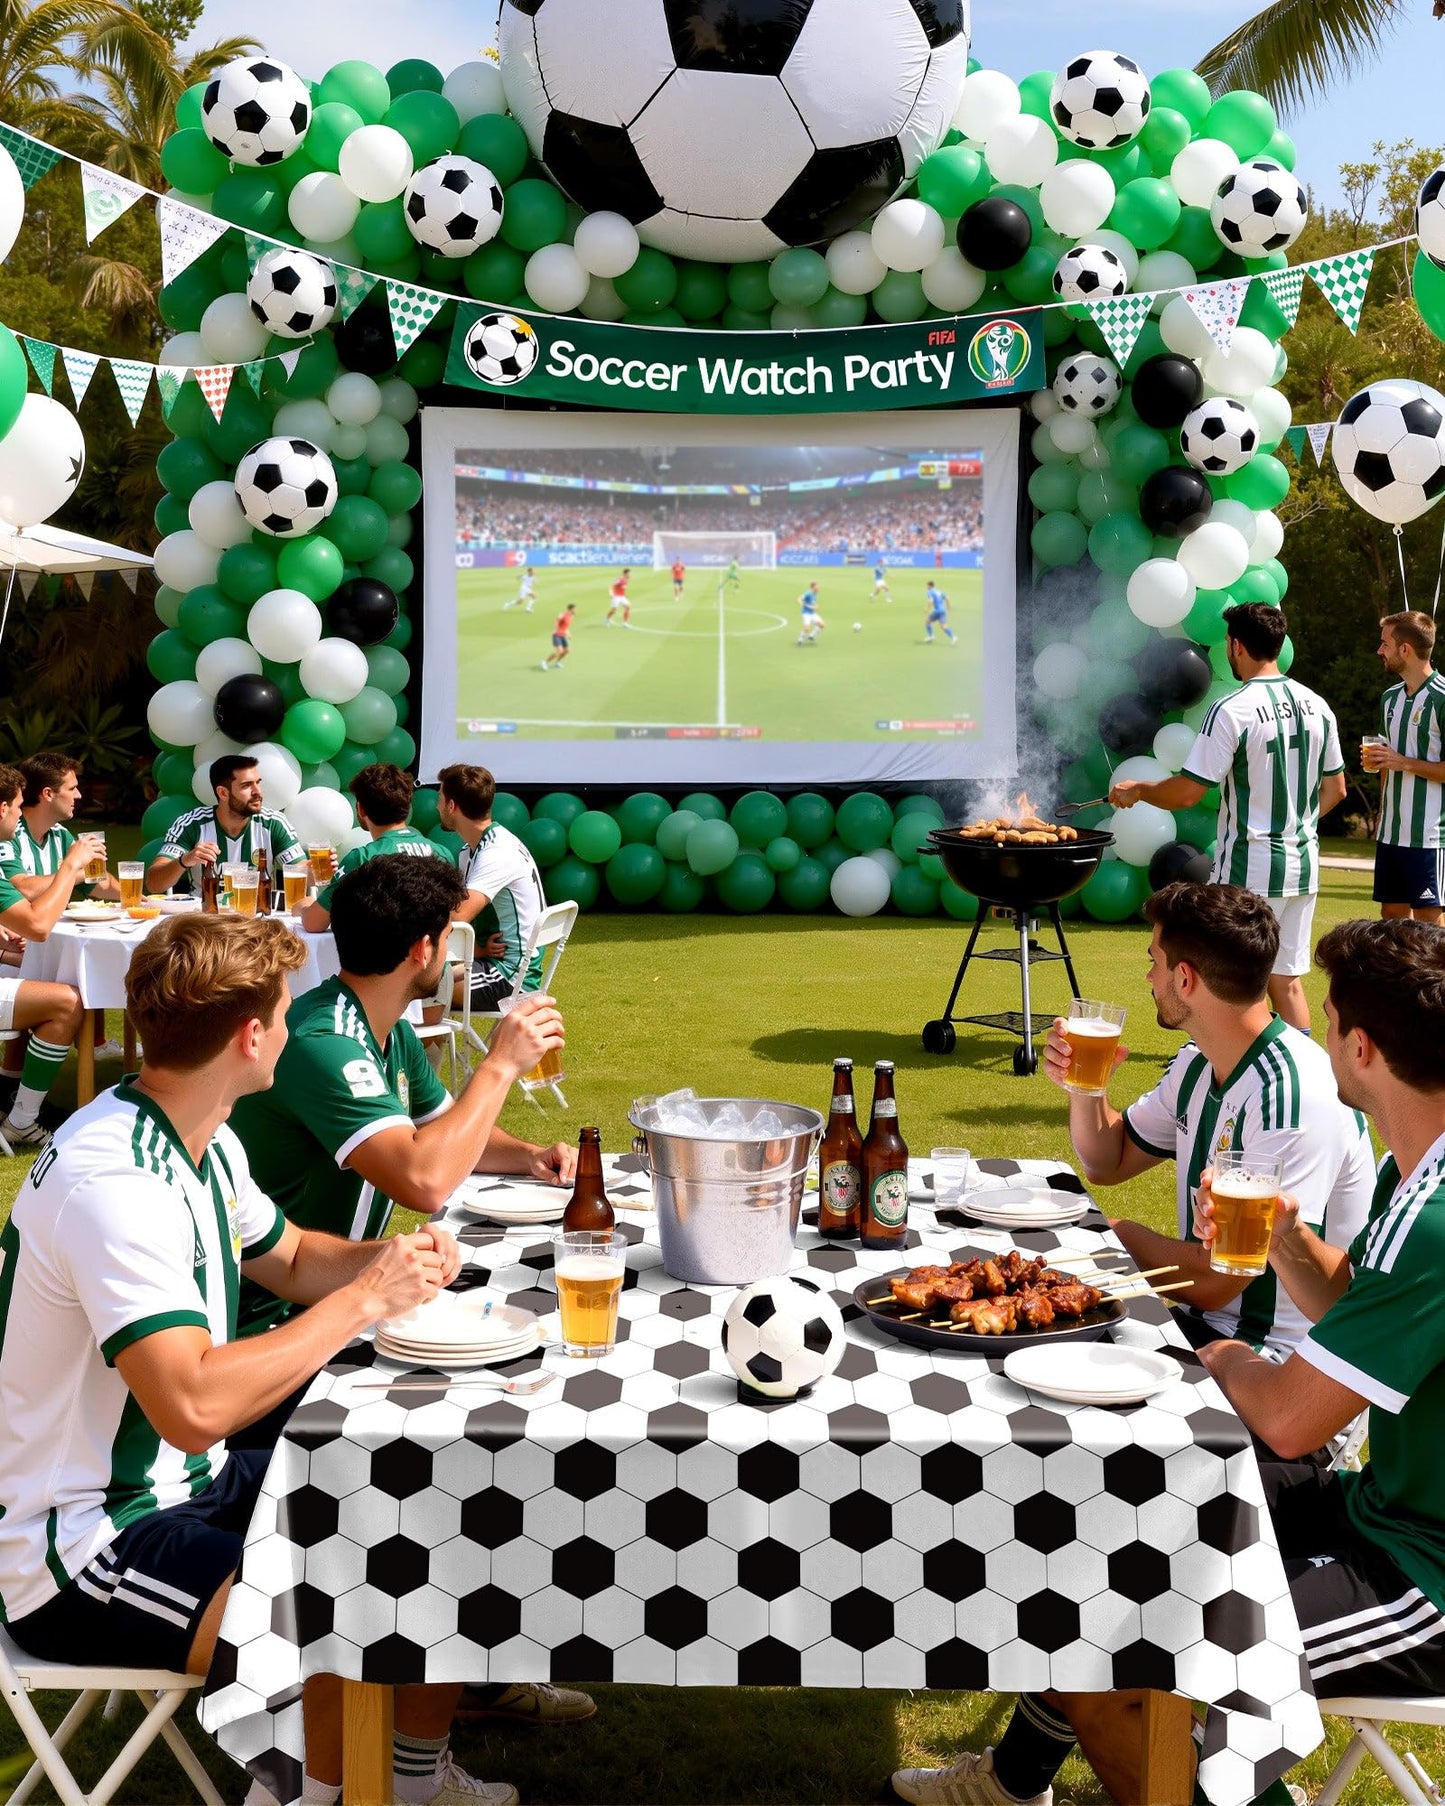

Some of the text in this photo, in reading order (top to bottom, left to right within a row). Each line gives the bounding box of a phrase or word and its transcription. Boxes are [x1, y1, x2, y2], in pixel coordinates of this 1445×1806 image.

[928, 330, 956, 346] FIFA
[545, 340, 955, 396] Soccer Watch Party
